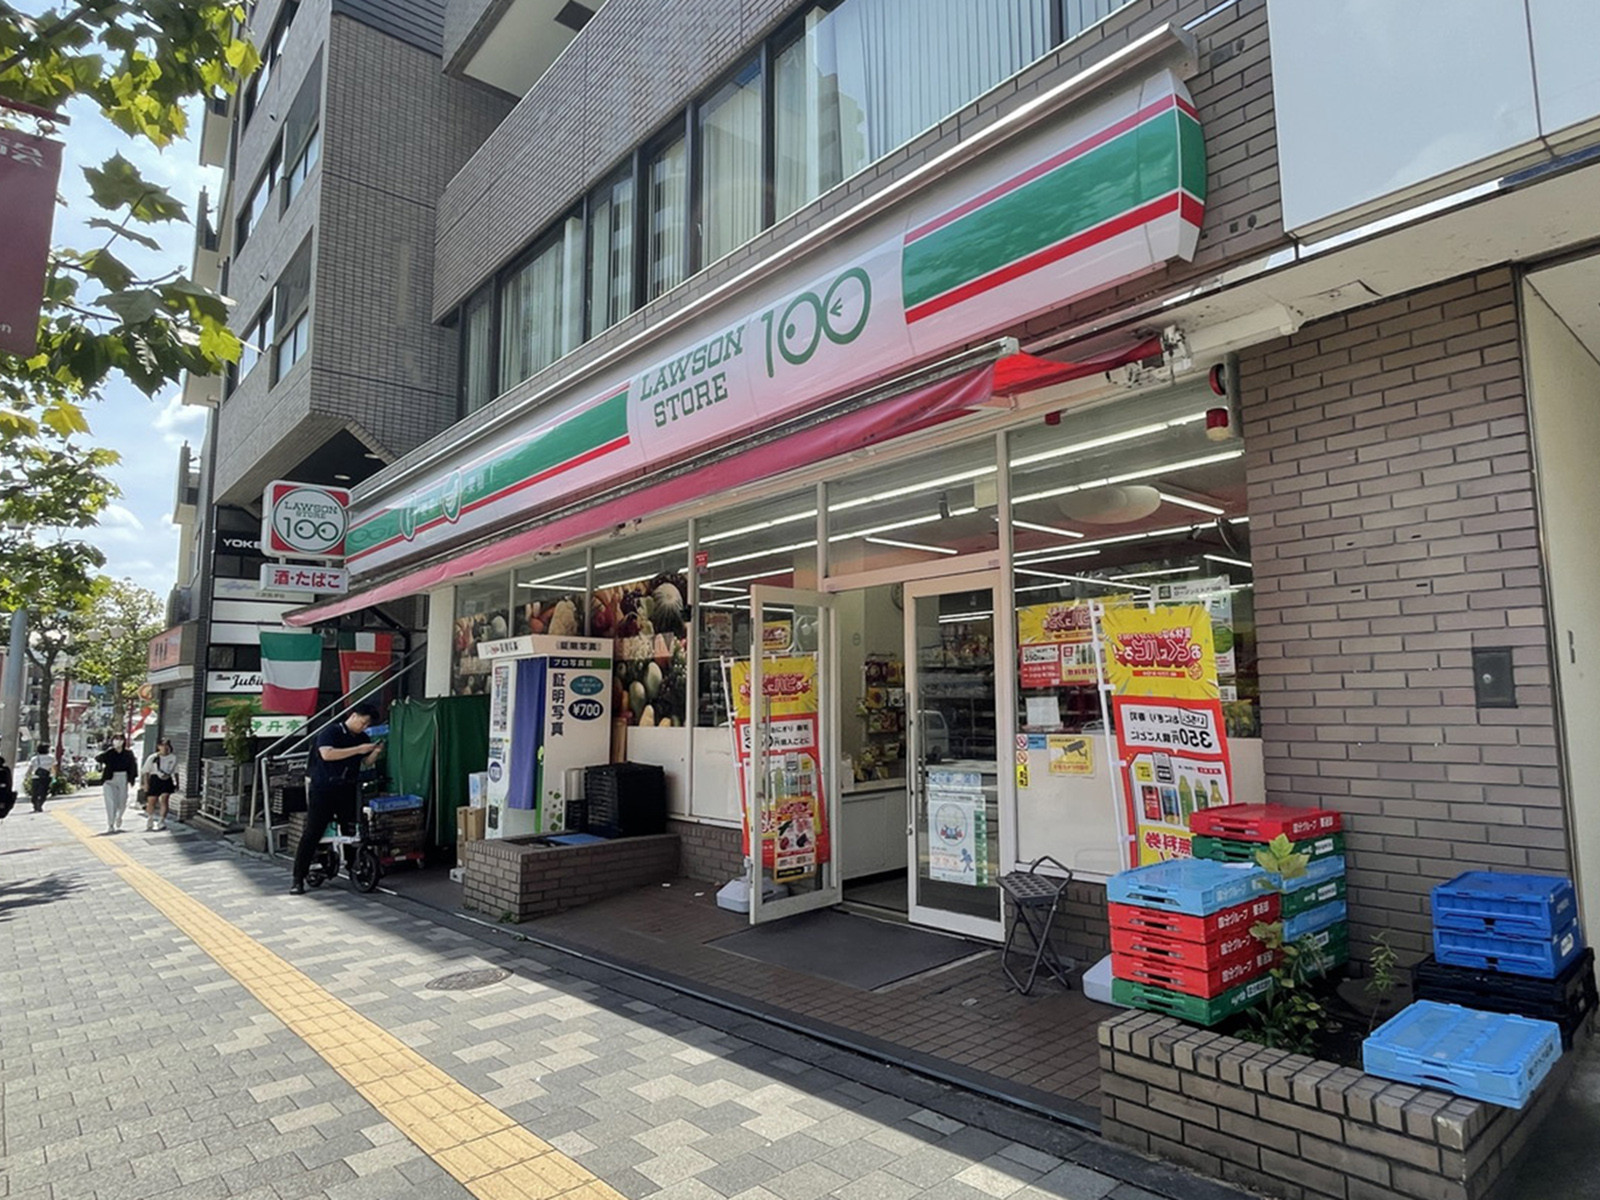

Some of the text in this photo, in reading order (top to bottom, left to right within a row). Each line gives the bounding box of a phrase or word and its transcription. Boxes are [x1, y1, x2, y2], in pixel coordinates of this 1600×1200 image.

[761, 267, 872, 378] 100
[640, 324, 745, 401] LAWSON
[653, 372, 728, 428] STORE
[283, 517, 339, 542] 100
[284, 501, 339, 515] LAWSON
[550, 672, 567, 737] 証明写真
[572, 704, 601, 717] ¥700
